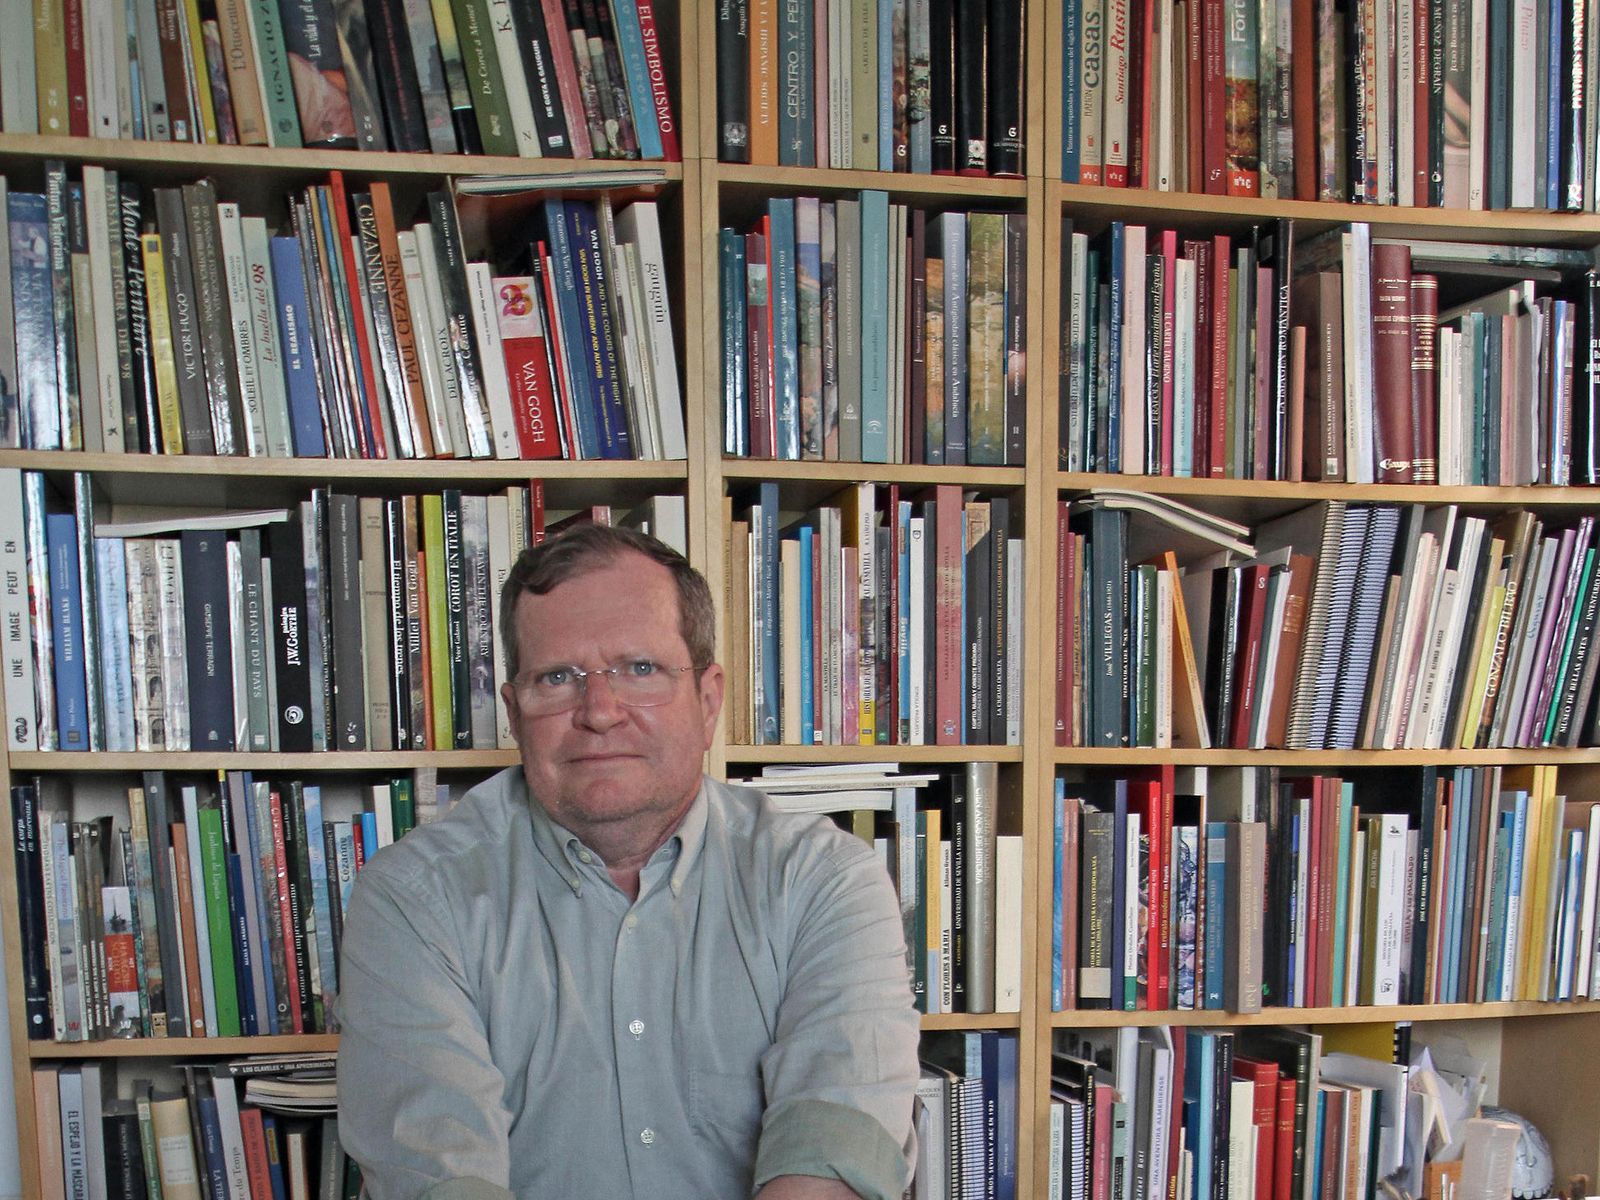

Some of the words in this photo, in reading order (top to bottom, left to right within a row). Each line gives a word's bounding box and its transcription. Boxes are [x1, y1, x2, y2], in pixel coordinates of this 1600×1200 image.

[466, 5, 479, 35] Monet
[639, 5, 651, 21] EL
[304, 24, 317, 40] vida
[787, 32, 798, 41] Y
[1067, 30, 1075, 45] siglo
[1401, 4, 1409, 80] EMIGRANTES
[263, 21, 284, 102] IGNACIO
[308, 44, 321, 56] La
[475, 49, 488, 77] Corot
[532, 40, 544, 76] GAUGUIN
[1083, 11, 1100, 88] casas
[642, 28, 672, 132] SIMBOLISMO
[787, 51, 799, 118] CENTRO
[1115, 56, 1126, 104] Santiago
[1433, 48, 1442, 94] DEGRAIN
[483, 80, 491, 94] De
[542, 84, 552, 104] GOYA
[546, 107, 553, 117] DE
[49, 172, 62, 214] Pintura
[120, 195, 141, 251] Mode
[51, 216, 66, 270] Victoriana
[590, 229, 600, 249] VAN
[252, 264, 266, 285] 98
[593, 251, 604, 280] GOGH
[113, 266, 125, 321] FIGURA
[255, 287, 266, 305] del
[385, 253, 409, 335] CEZANNE
[597, 282, 606, 300] AND
[644, 263, 666, 324] gauguin
[127, 266, 146, 356] Peinture
[177, 293, 192, 332] HUGO
[600, 302, 608, 317] THE
[1164, 312, 1172, 320] EL
[258, 308, 270, 344] huella
[285, 304, 299, 354] REALISMO
[602, 319, 613, 352] COLORS
[1164, 322, 1172, 348] CARTEL
[117, 328, 127, 357] DEL
[180, 334, 196, 380] VICTOR
[238, 320, 252, 364] OMBRES
[262, 347, 273, 361] La
[120, 364, 130, 380] 98
[292, 359, 300, 370] EL
[404, 340, 418, 384] PAUL
[438, 327, 457, 399] DELACROIX
[521, 360, 537, 392] VAN
[609, 365, 617, 379] THE
[1163, 349, 1171, 383] TAURINO
[244, 376, 258, 414] SOLEIL
[611, 381, 621, 406] NIGHT
[526, 395, 544, 443] GOGH
[448, 511, 459, 551] ITALIE
[5, 541, 16, 553] EN
[449, 553, 460, 571] EN
[7, 570, 18, 595] PEUT
[247, 583, 257, 596] LE
[408, 560, 419, 591] Gogh
[409, 594, 419, 614] Van
[450, 573, 462, 613] COROT
[1495, 581, 1518, 630] BILBAO
[1583, 579, 1600, 621] INVENTARIO
[61, 596, 70, 624] BLAKE
[249, 601, 259, 641] CHANT
[9, 612, 21, 642] IMAGE
[410, 621, 421, 653] Millet
[1104, 612, 1113, 661] VILLEGAS
[63, 625, 73, 661] WILLIAM
[251, 649, 260, 665] DU
[1575, 635, 1588, 661] ARTES
[13, 658, 23, 678] UNE
[205, 641, 215, 677] TERRAGNI
[1105, 662, 1113, 677] José
[1485, 633, 1508, 698] GONZALO
[252, 670, 262, 697] PAYS
[1567, 663, 1582, 691] BELLAS
[1564, 693, 1574, 704] DE
[1559, 706, 1572, 734] MUSEO
[16, 819, 26, 840] corps
[25, 800, 33, 840] morceaux
[17, 841, 26, 852] Le
[27, 842, 34, 851] en
[1406, 856, 1415, 896] MACHADO
[290, 883, 304, 950] impresionismo
[942, 929, 950, 954] MARIA
[296, 951, 304, 967] del
[296, 968, 306, 1004] Crónica
[1156, 1076, 1164, 1125] ALMERIENSE
[233, 1147, 244, 1175] Temps
[1154, 1128, 1162, 1166] AVENTURA
[237, 1177, 245, 1190] du
[1169, 1175, 1177, 1197] Artistas
